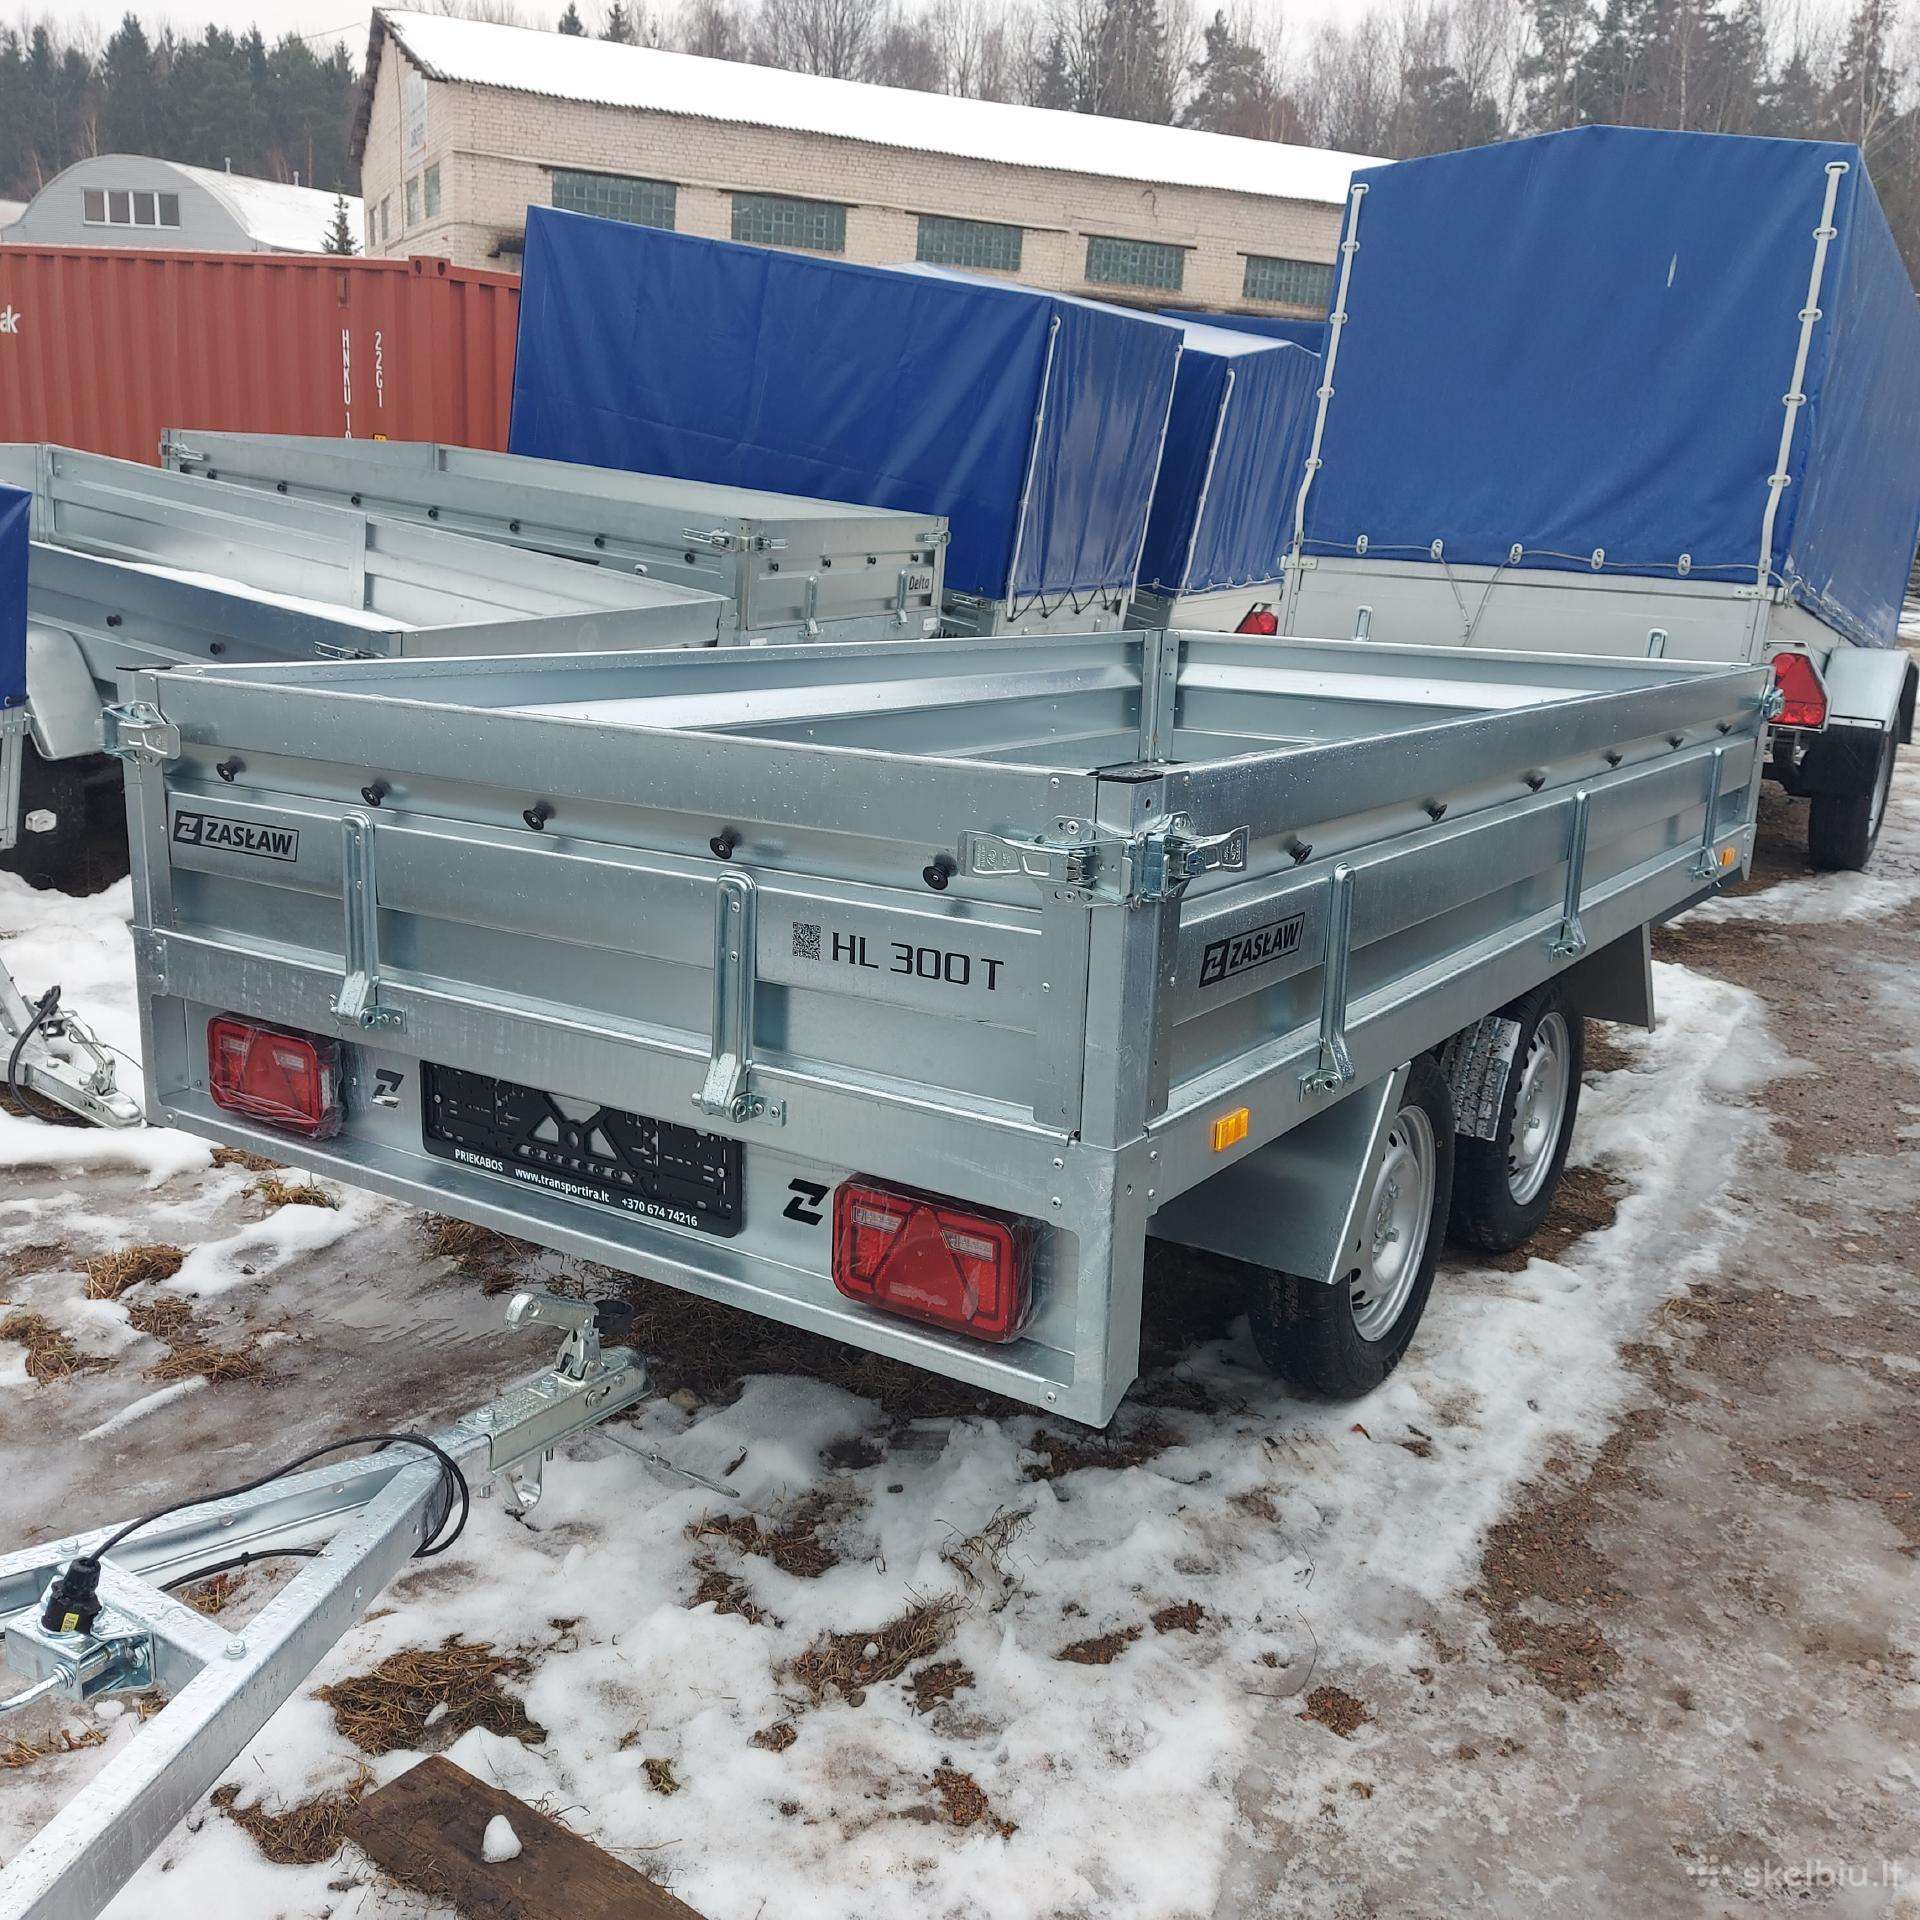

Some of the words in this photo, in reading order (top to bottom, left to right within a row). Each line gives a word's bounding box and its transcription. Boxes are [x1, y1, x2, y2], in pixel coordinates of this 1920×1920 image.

[342, 328, 351, 404] HNKU
[375, 331, 383, 408] 22G1
[205, 821, 294, 855] ZASŁAW
[831, 931, 879, 969] HL
[890, 942, 970, 986] 300
[980, 958, 1005, 991] T
[1229, 920, 1300, 970] ZASŁAW
[454, 1148, 504, 1172] PRIEKABOS
[514, 1167, 610, 1203] www.transportira.lt
[621, 1197, 645, 1213] +370
[647, 1203, 665, 1218] 674
[667, 1208, 698, 1227] 74216
